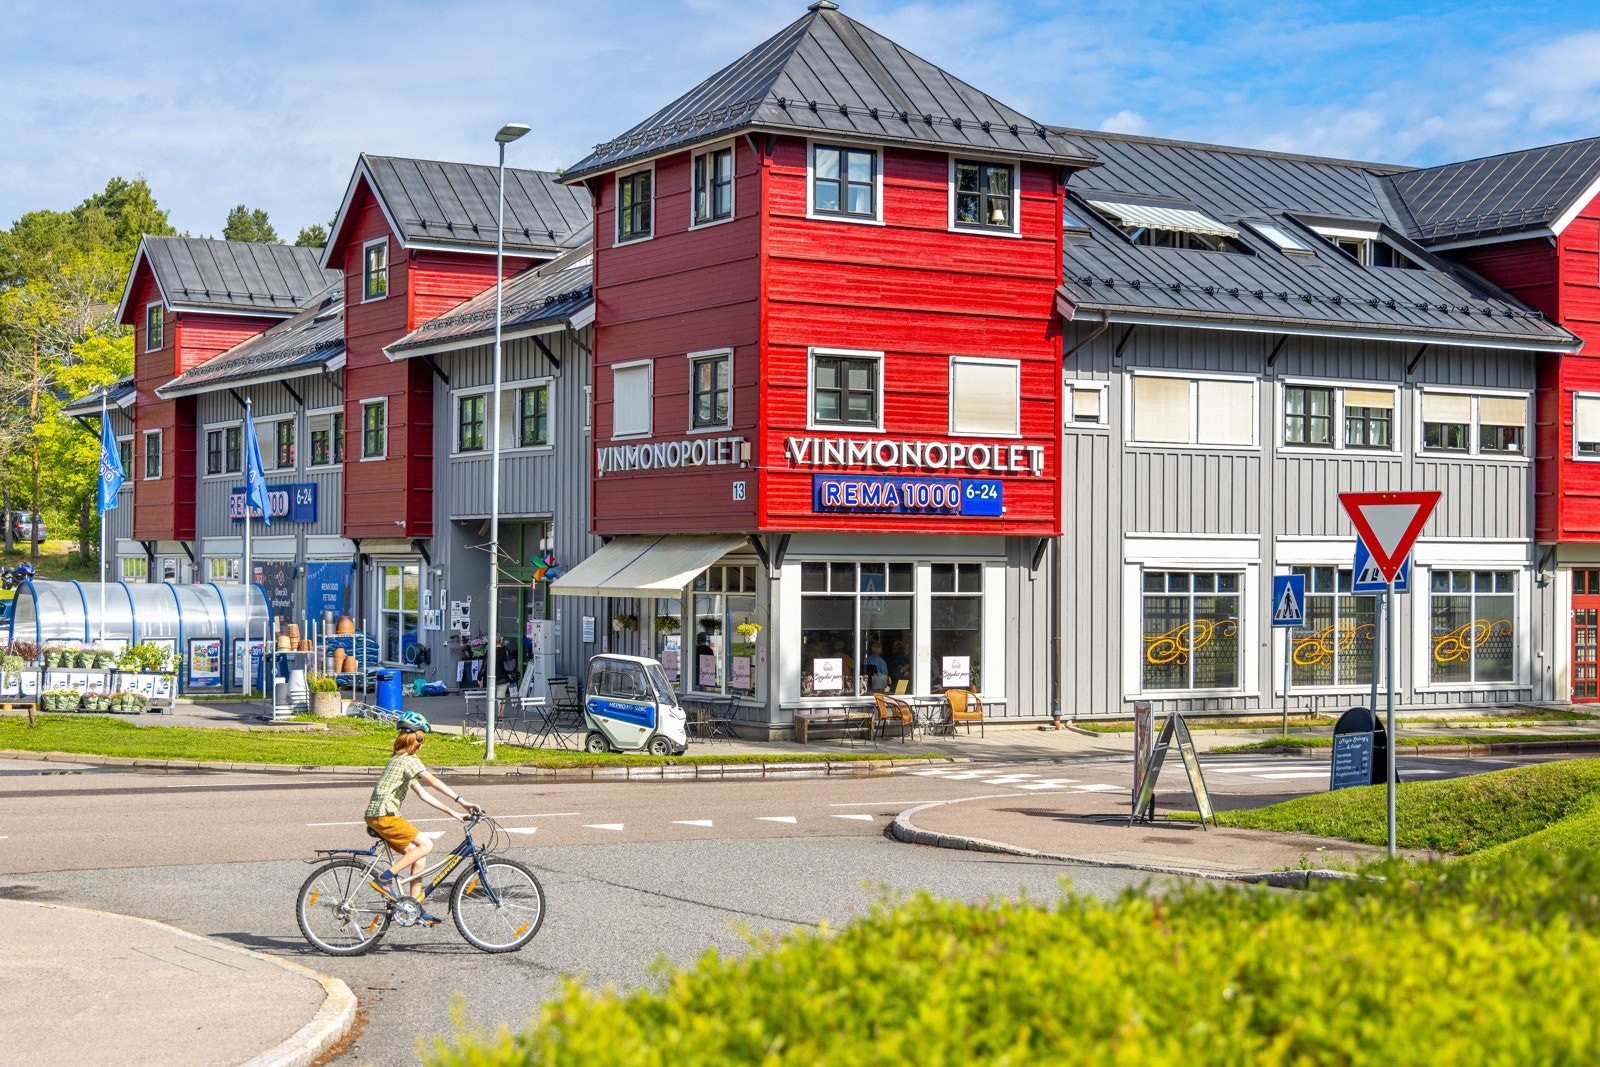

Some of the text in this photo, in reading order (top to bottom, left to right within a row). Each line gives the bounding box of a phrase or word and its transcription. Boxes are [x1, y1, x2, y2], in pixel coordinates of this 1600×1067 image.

[597, 437, 744, 473] VINMONOPOLET
[788, 437, 1044, 471] VINMONOPOLET
[296, 488, 312, 505] 6-24
[733, 483, 745, 499] 13
[822, 481, 998, 508] REMA 1000 6-24
[432, 855, 462, 887] MERIDA
